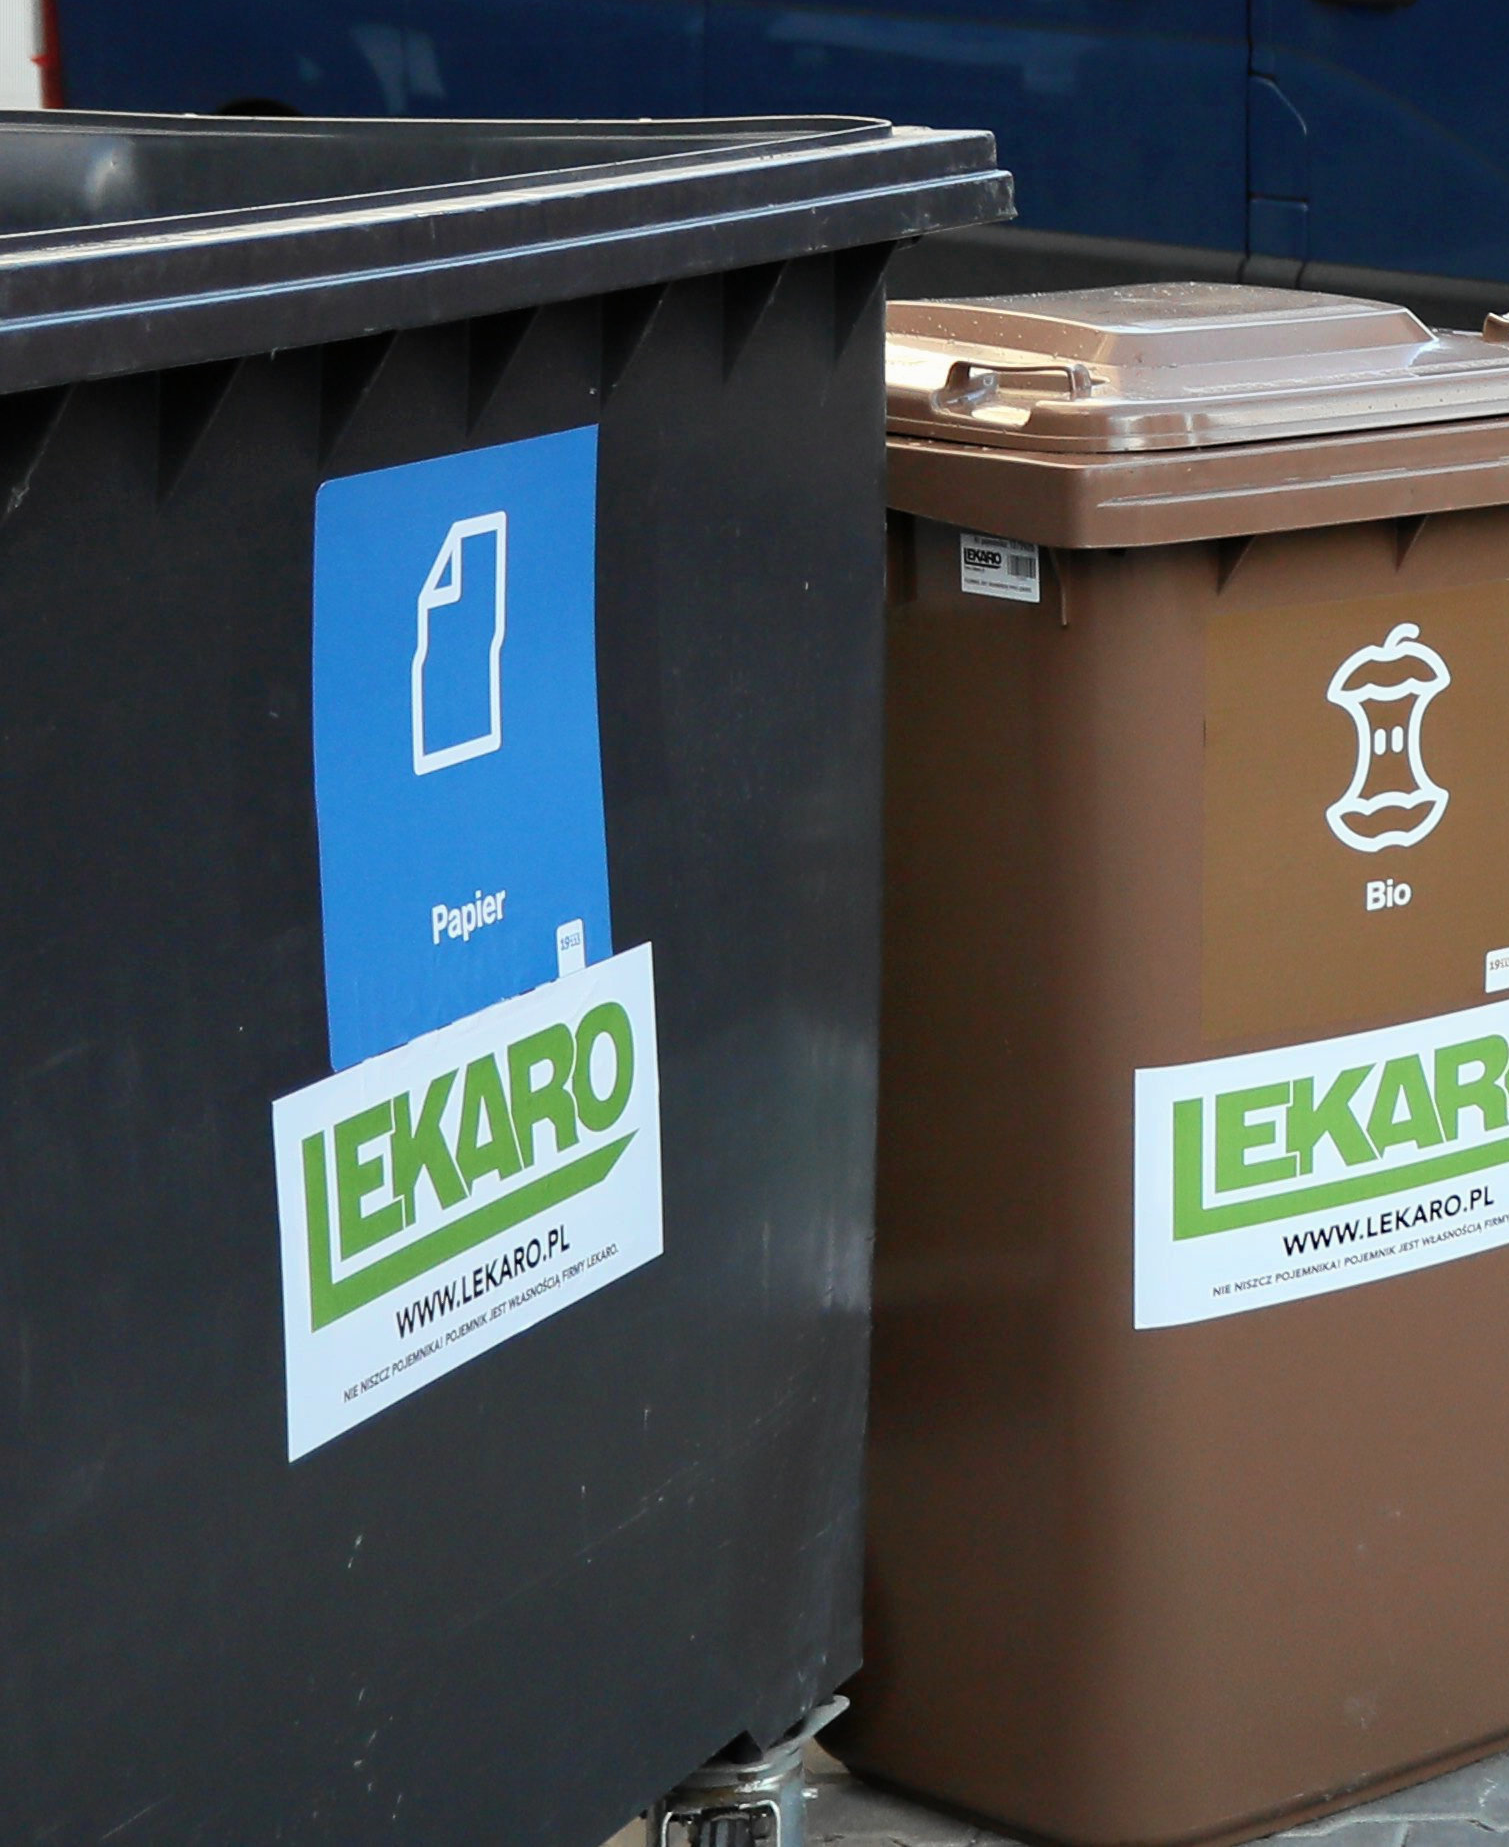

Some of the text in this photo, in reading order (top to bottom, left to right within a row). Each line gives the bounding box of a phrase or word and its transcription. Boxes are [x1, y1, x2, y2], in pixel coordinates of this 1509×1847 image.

[432, 887, 506, 945] Papier
[1365, 879, 1412, 911] Bio
[302, 1002, 639, 1332] LEKARO
[1283, 1185, 1496, 1257] WWW.LEKARO.PL
[395, 1224, 570, 1338] WWW.LEKARO.PL
[1212, 1285, 1231, 1297] NIE
[1234, 1274, 1273, 1291] NISZCZ
[1275, 1260, 1340, 1283] POJEMNIKA!
[1344, 1244, 1396, 1266] POJEMNIK
[1397, 1238, 1420, 1253] JEST
[1421, 1222, 1483, 1248] WŁASNOŚCIĄ
[343, 1386, 359, 1403] NIE
[360, 1367, 390, 1394] NISZCZ
[391, 1338, 443, 1376] POJEMNIKA!
[445, 1313, 488, 1345] POJEMNIK
[489, 1302, 507, 1323] JEST
[508, 1276, 561, 1310] WŁASNOŚCIĄ
[562, 1263, 585, 1283] FIRMY
